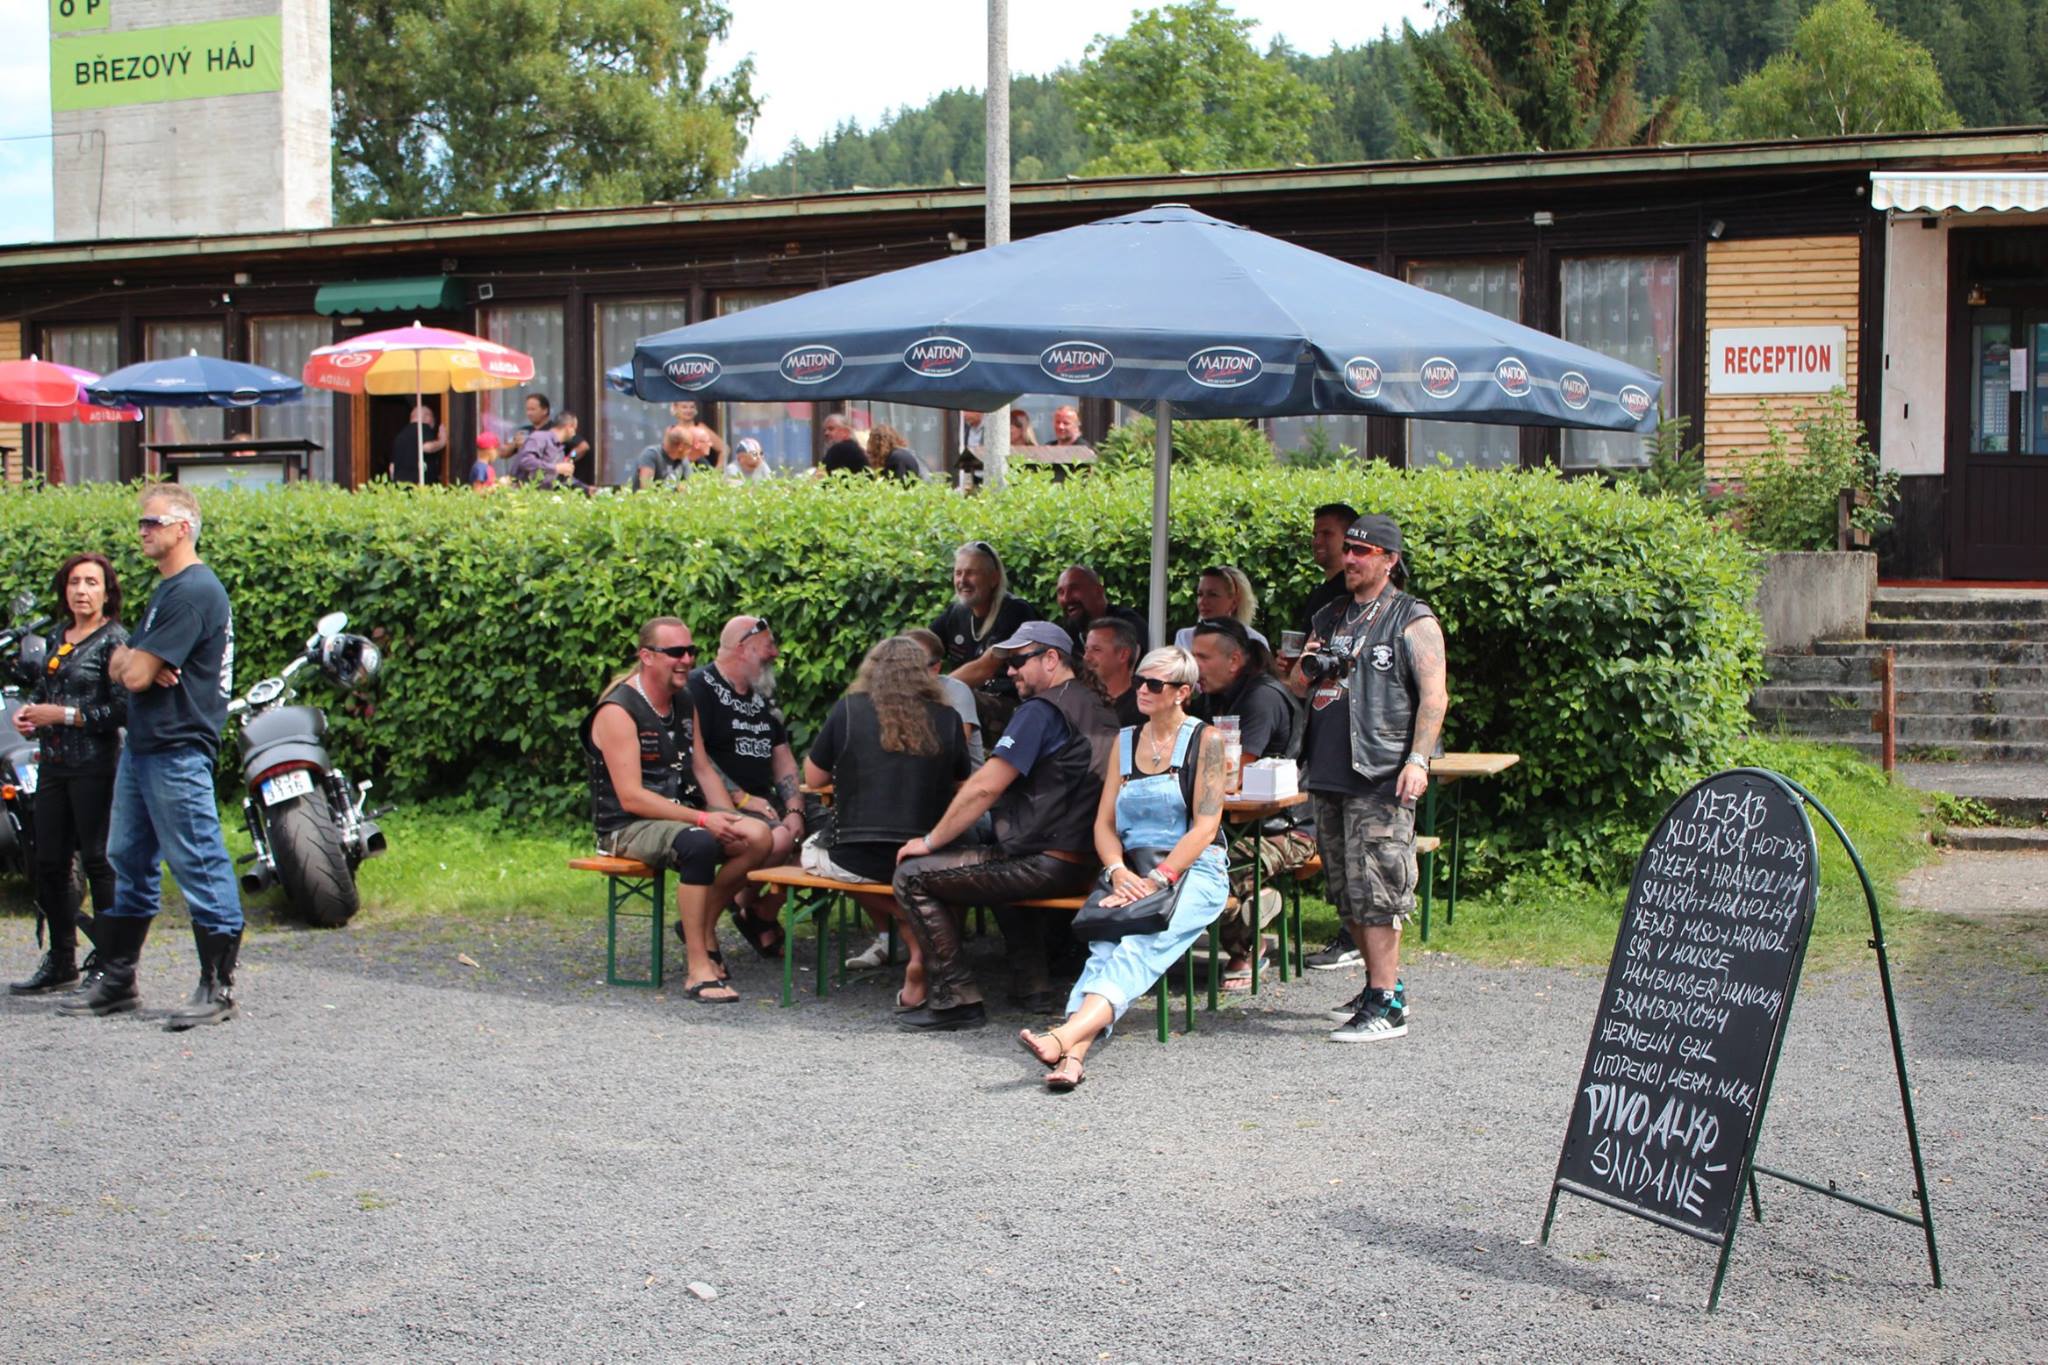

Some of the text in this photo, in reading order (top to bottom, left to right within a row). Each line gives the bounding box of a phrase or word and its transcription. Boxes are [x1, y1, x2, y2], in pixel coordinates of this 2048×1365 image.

[76, 41, 254, 85] BŘEZOVÝ HÁJ
[787, 352, 835, 368] MATTONI
[912, 346, 963, 360] MATTONI
[1048, 350, 1105, 365] MATTONI
[1196, 355, 1254, 370] MATTONI
[1724, 344, 1832, 375] RECEPTION
[669, 361, 714, 375] MATTONI
[1692, 788, 1768, 830] KEBAB
[1751, 832, 1785, 857] HOT
[1652, 1095, 1720, 1159] ALKO
